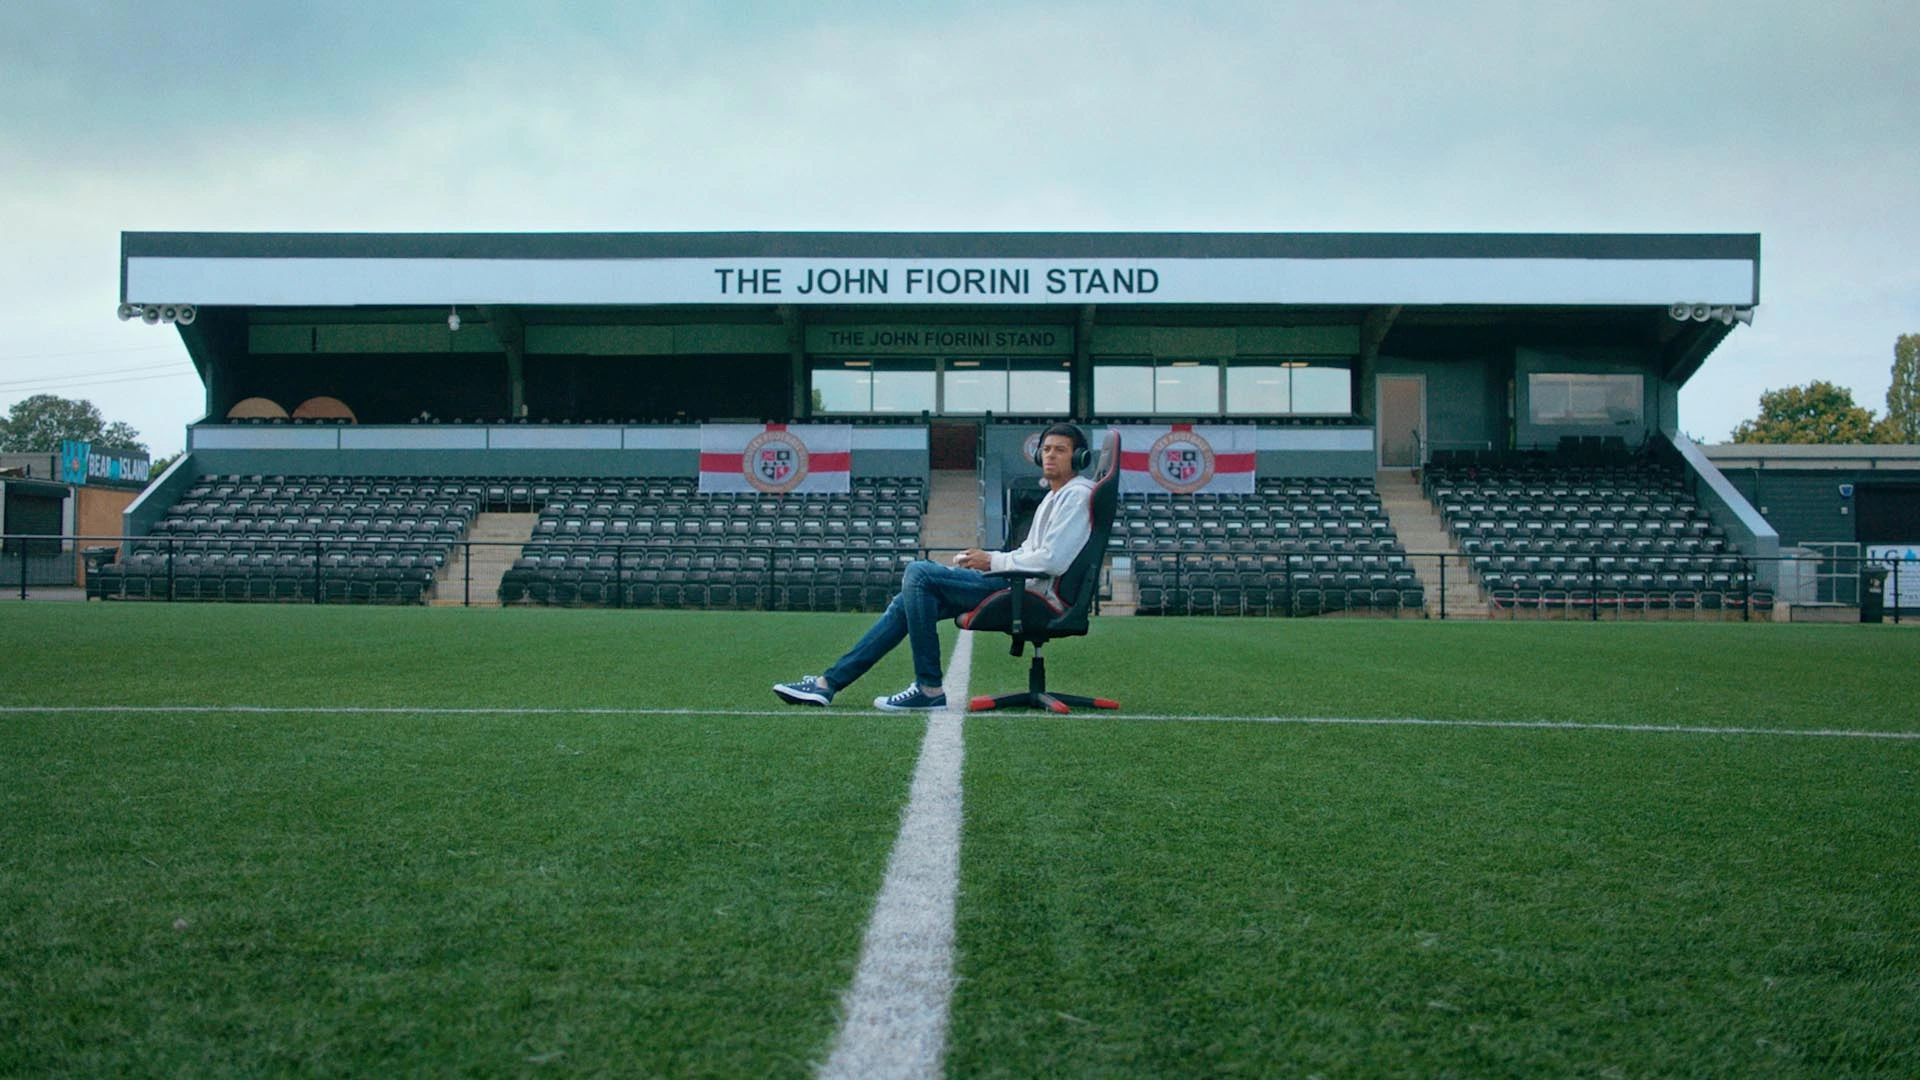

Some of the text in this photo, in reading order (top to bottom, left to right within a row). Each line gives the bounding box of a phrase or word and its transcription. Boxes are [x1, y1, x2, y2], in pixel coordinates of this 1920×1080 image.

[715, 268, 1160, 295] THE JOHN FIORINI STAND
[829, 332, 1055, 346] THE JOHN FIORINI STAND
[89, 453, 149, 481] BEAR ISLAND
